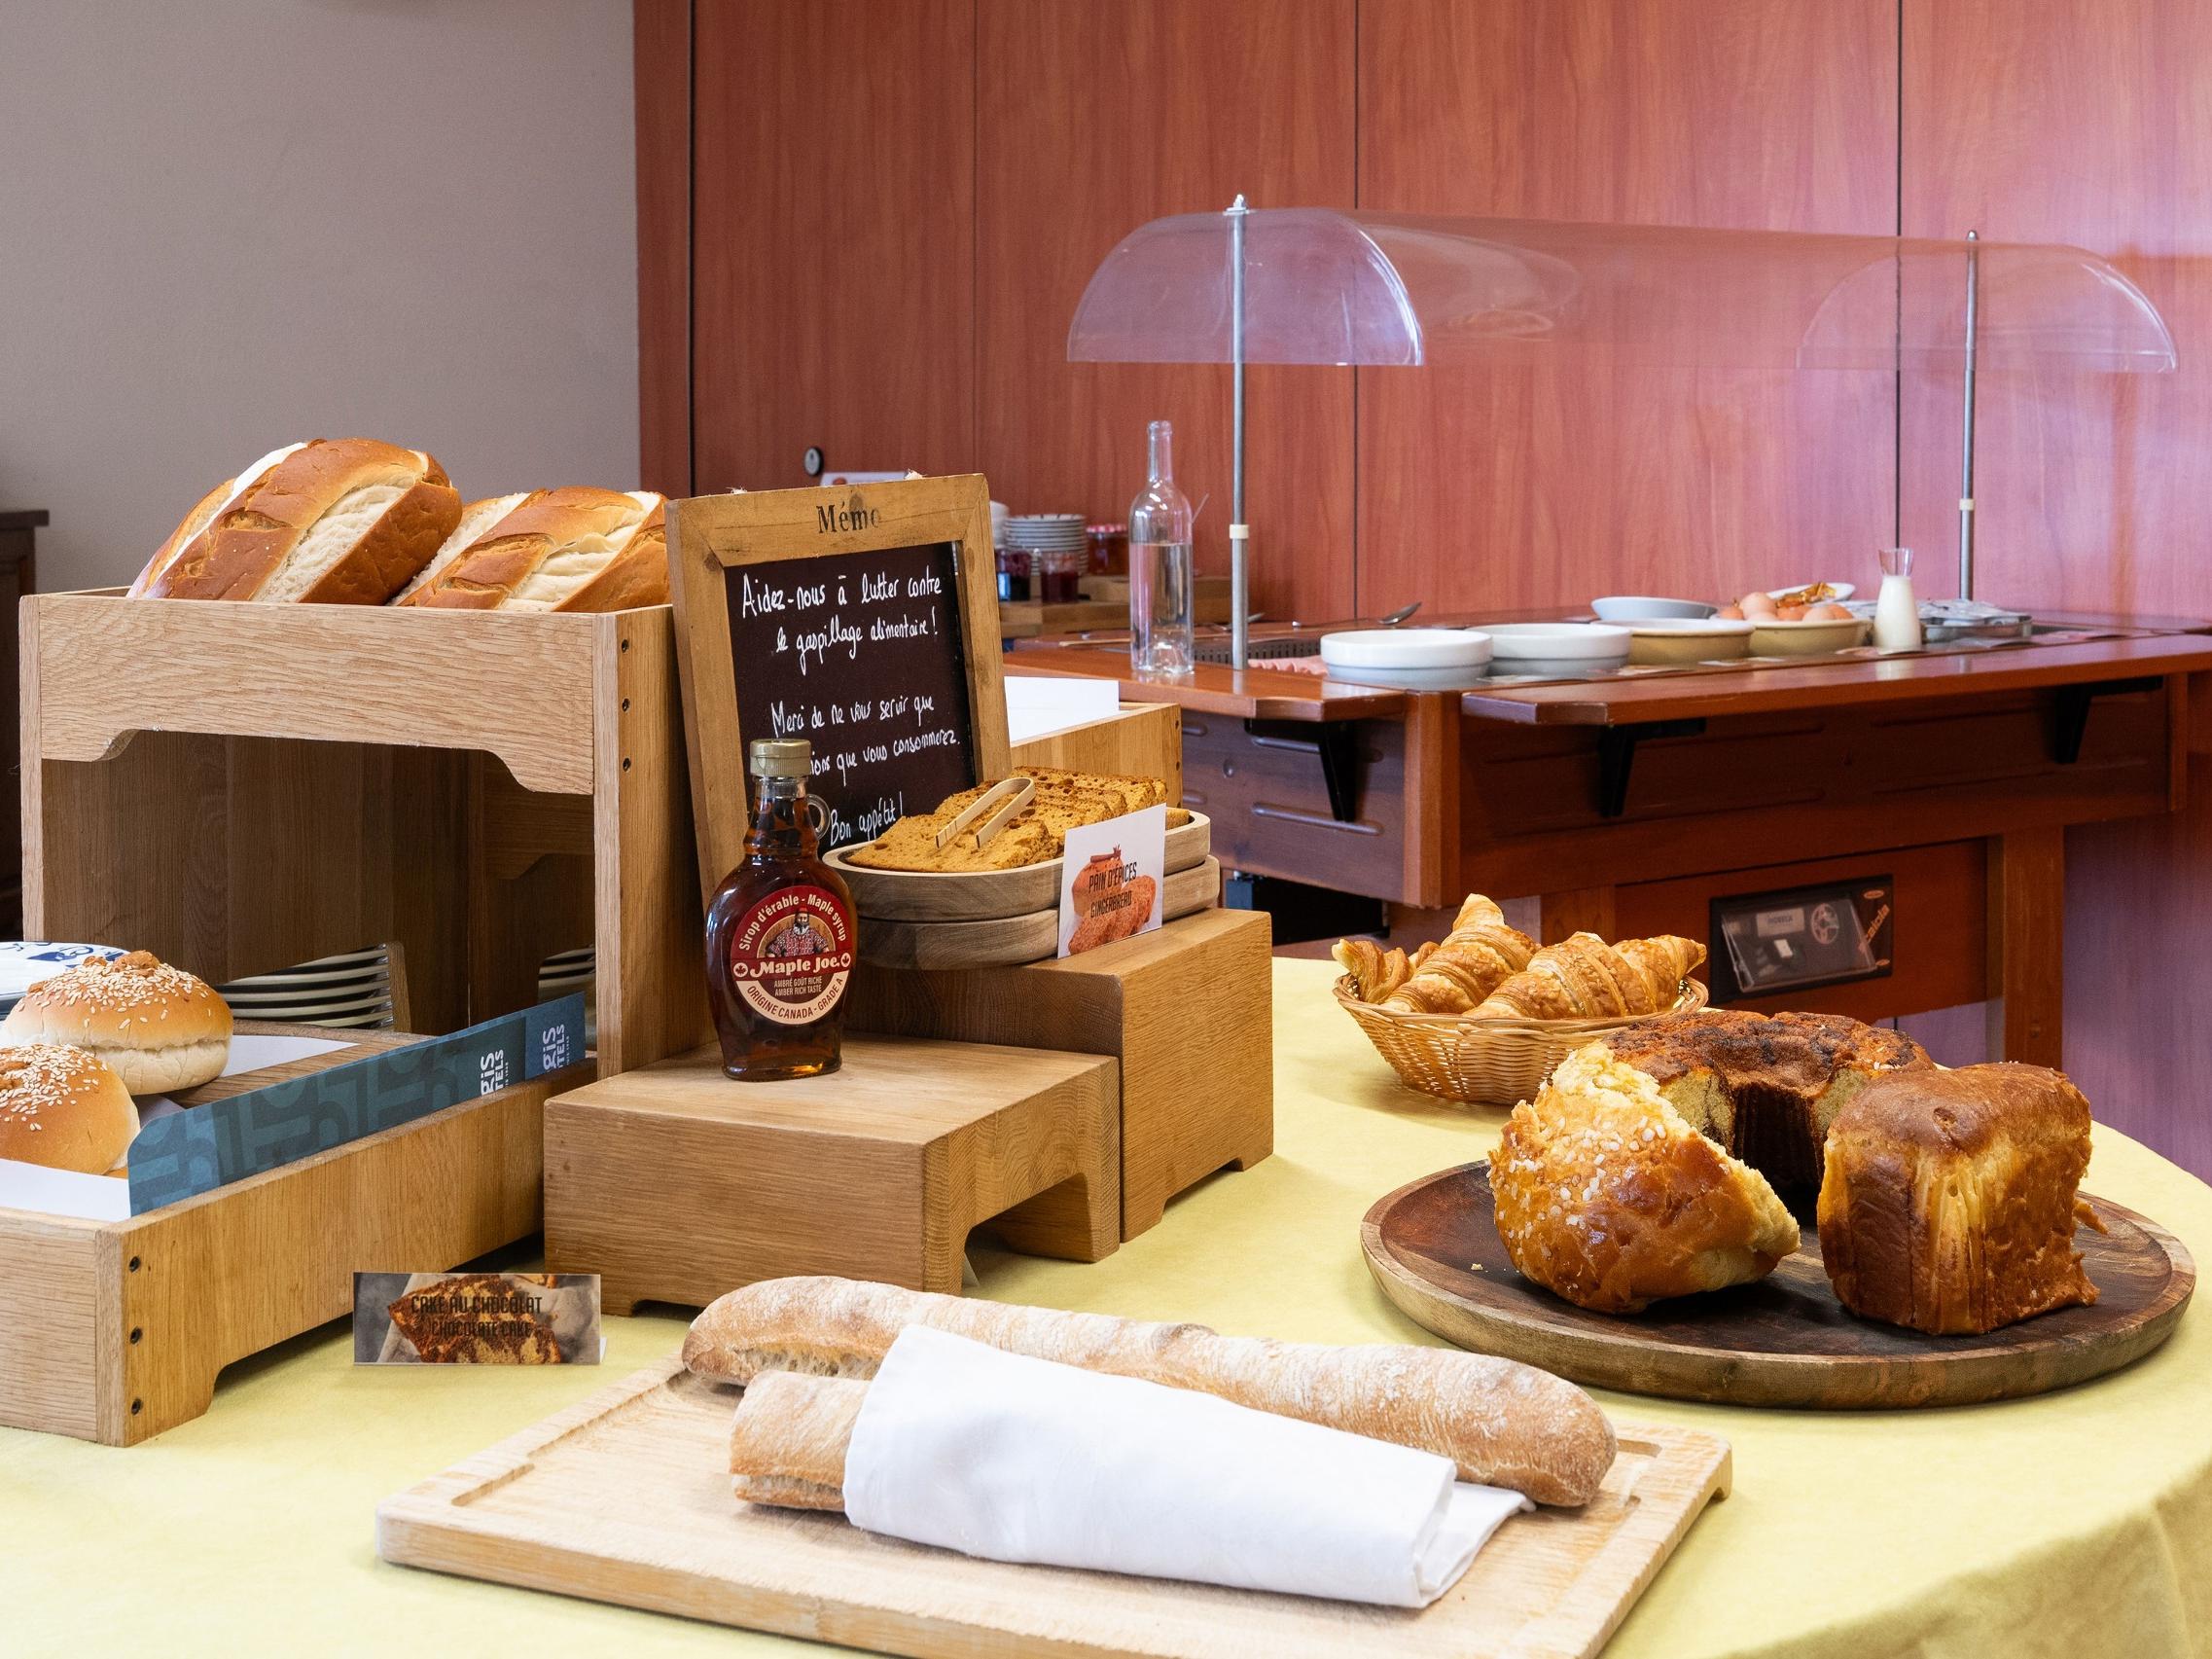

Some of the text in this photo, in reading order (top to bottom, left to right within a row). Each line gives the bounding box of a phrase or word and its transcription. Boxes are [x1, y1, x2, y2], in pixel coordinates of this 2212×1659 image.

[815, 500, 881, 533] Mémo
[742, 572, 826, 619] Aidez-nous
[861, 571, 899, 604] lutter
[908, 564, 942, 597] contre
[796, 614, 863, 676] gaspillage
[770, 700, 805, 739] Merci
[811, 705, 826, 729] de
[849, 700, 872, 723] vous
[879, 694, 909, 721] servir
[913, 695, 935, 728] que
[809, 750, 831, 776] ions
[837, 751, 859, 787] que
[862, 745, 888, 764] vous
[830, 809, 852, 843] Bon
[1088, 872, 1107, 894] PAIN
[738, 920, 761, 952] Sirop
[757, 894, 800, 923] d'érable
[806, 893, 835, 916] Maple
[831, 912, 847, 942] syrup
[1090, 890, 1132, 919] GINGERBREAD
[749, 958, 811, 979] Maple
[747, 985, 779, 1015] ORIGINE
[778, 1006, 814, 1020] CANADA
[817, 984, 841, 1012] GRADE
[836, 977, 844, 987] A
[556, 1024, 565, 1068] TELS
[410, 1295, 543, 1315] CAKE AU CHOCOLAT
[432, 1320, 532, 1339] CHOCOLATE CAKE
